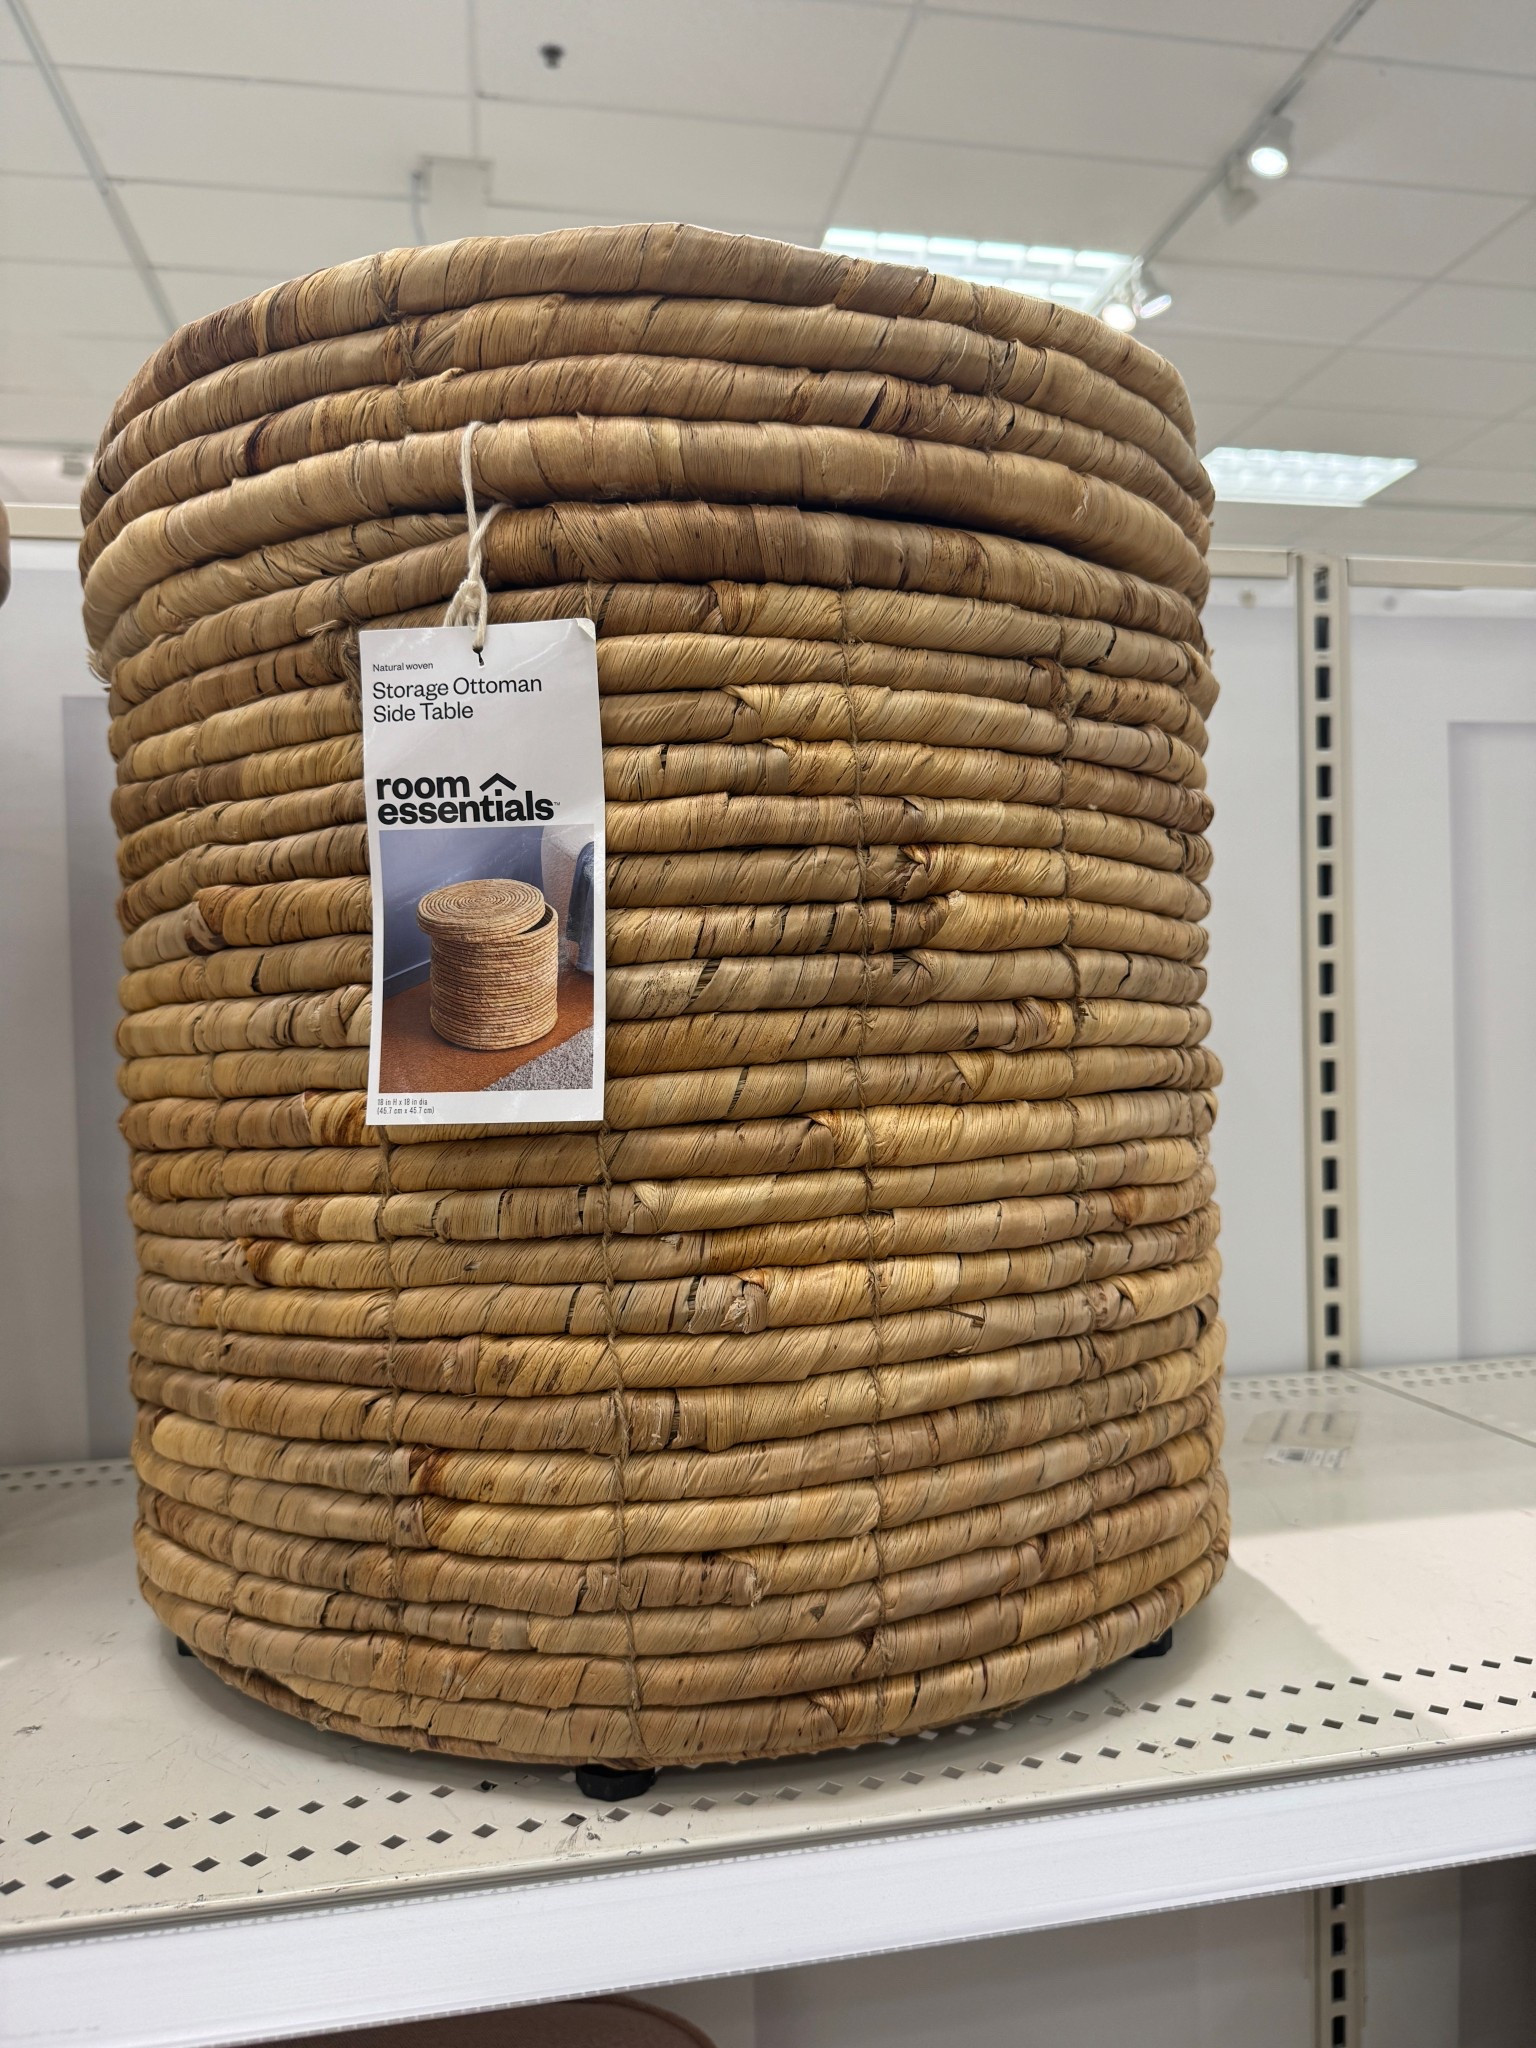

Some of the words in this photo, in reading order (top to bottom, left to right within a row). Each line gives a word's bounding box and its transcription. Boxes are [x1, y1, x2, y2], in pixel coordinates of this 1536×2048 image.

[372, 663, 404, 672] Natural
[406, 662, 433, 670] woven
[373, 681, 448, 700] Storage
[453, 677, 542, 695] Ottoman
[373, 704, 416, 722] Side
[419, 702, 474, 720] Table
[376, 776, 470, 800] room
